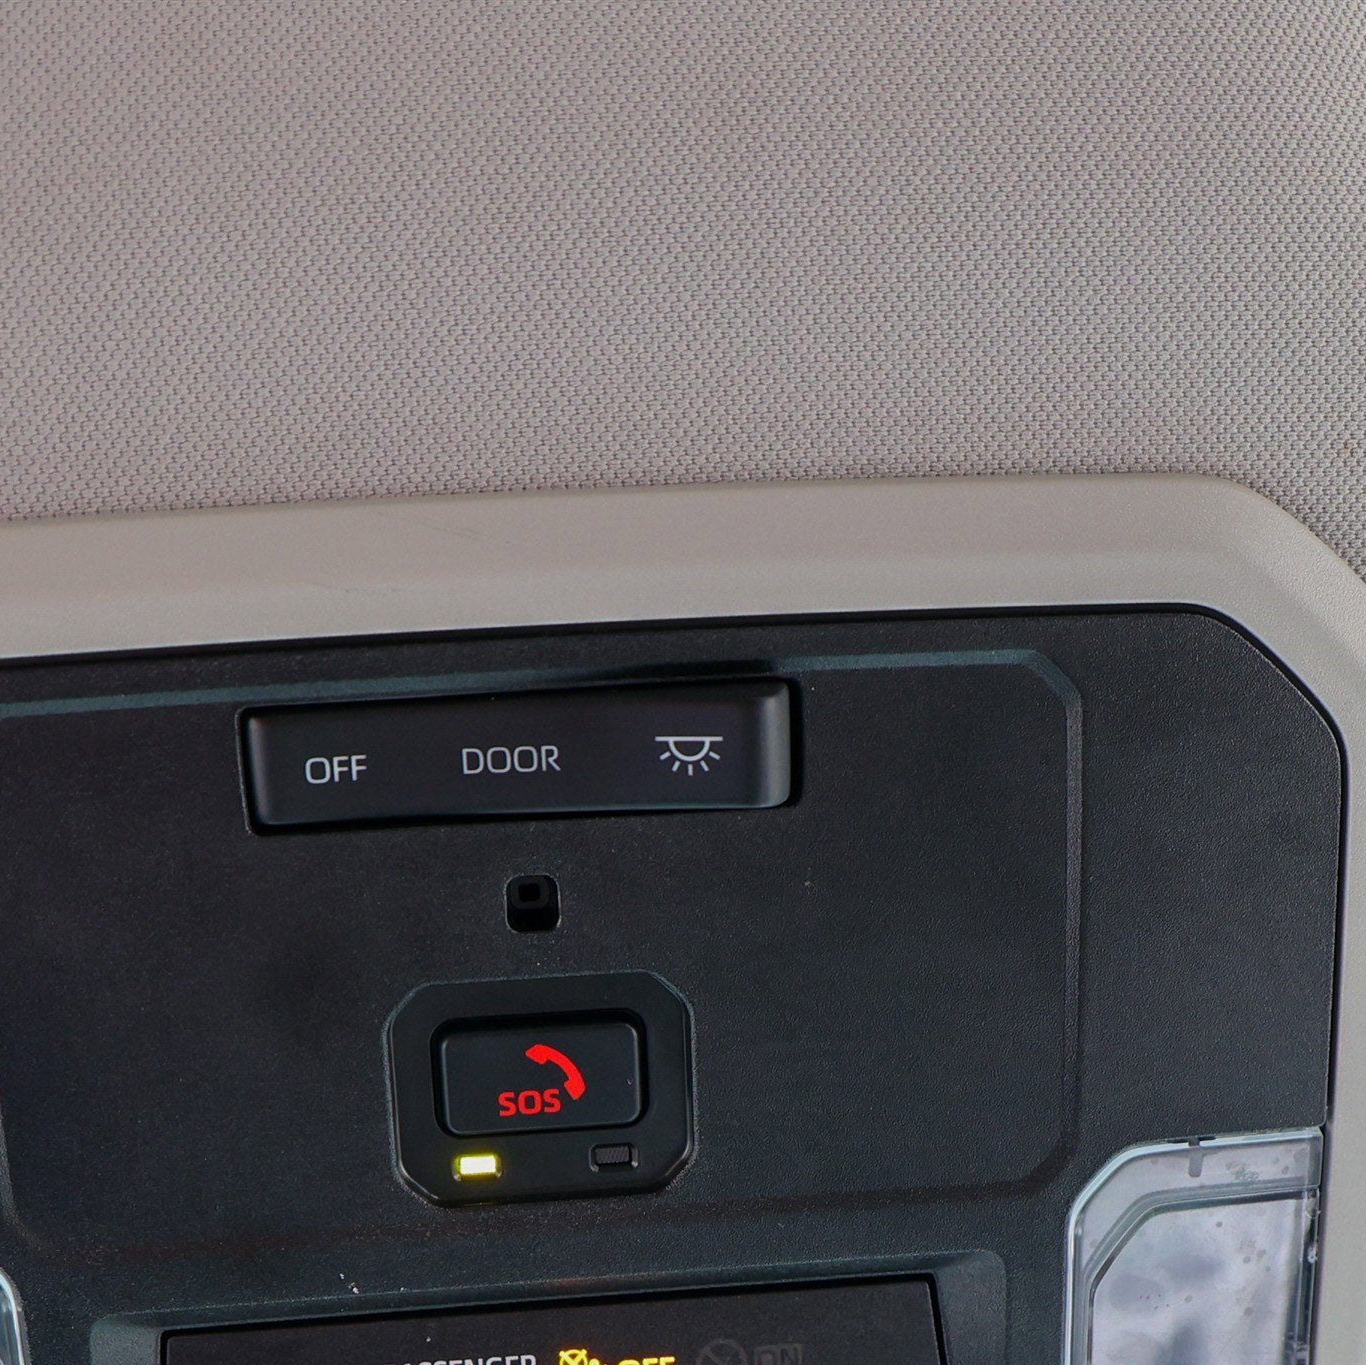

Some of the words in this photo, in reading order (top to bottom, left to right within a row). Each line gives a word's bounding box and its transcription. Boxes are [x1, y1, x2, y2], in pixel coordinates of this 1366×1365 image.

[304, 754, 367, 784] OFF
[461, 745, 561, 775] DOOR
[497, 1088, 562, 1117] SOS
